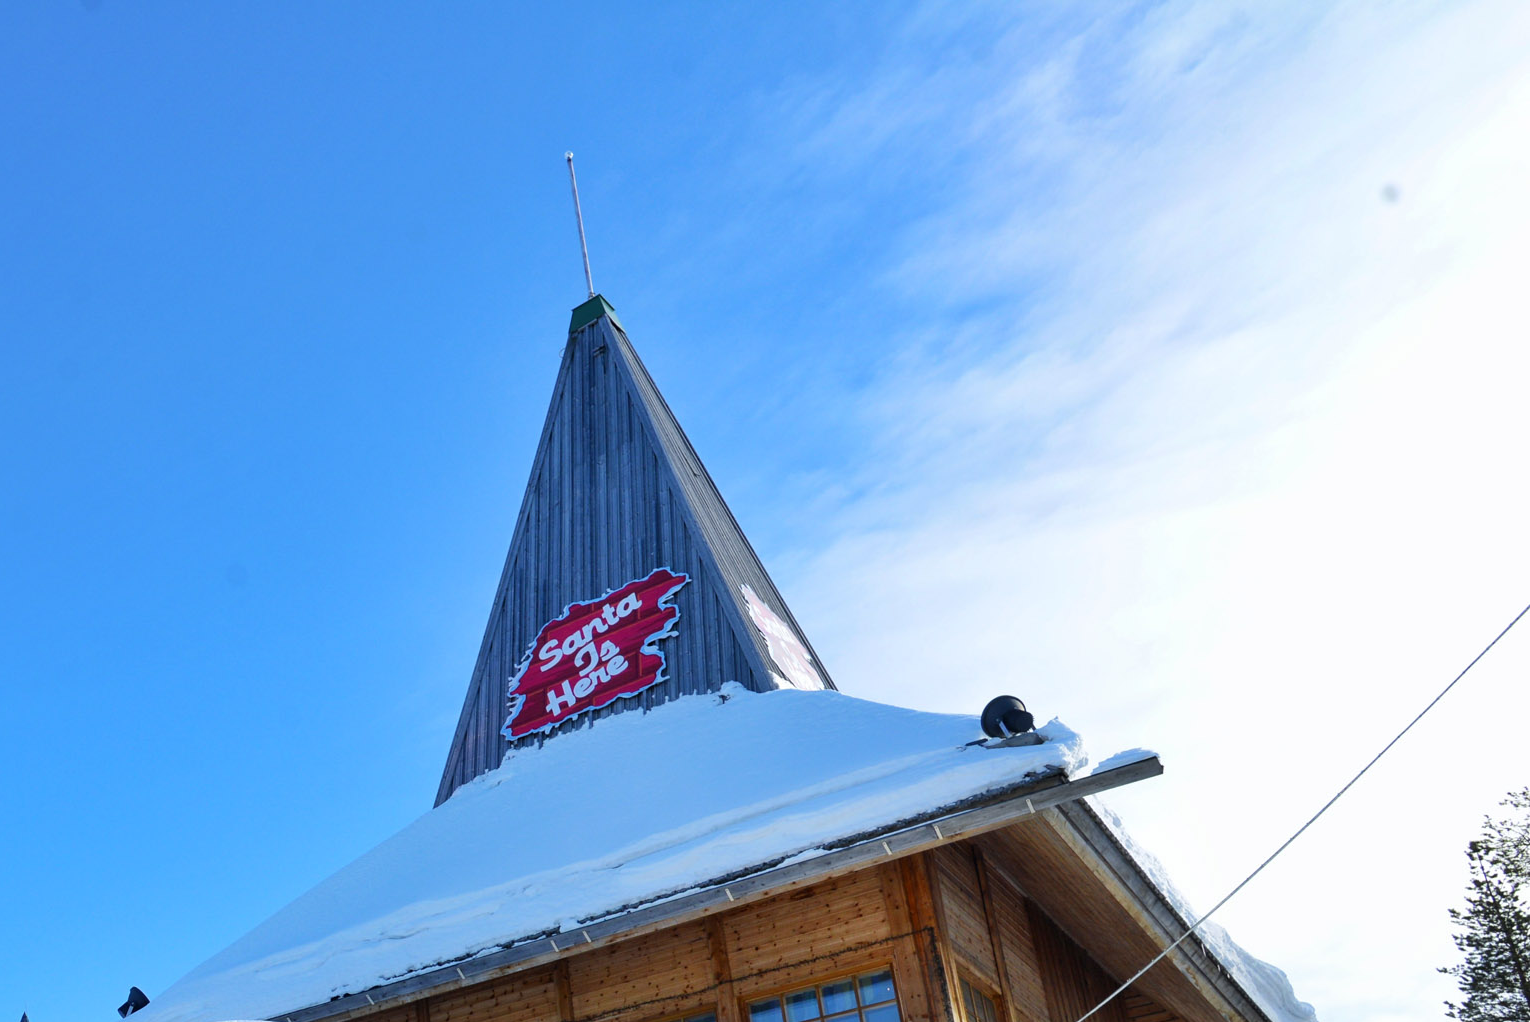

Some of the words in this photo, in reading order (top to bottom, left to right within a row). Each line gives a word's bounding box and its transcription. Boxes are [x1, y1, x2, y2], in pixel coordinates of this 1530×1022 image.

[538, 592, 642, 672] Santa
[574, 639, 620, 677] Is
[545, 653, 628, 717] Here
